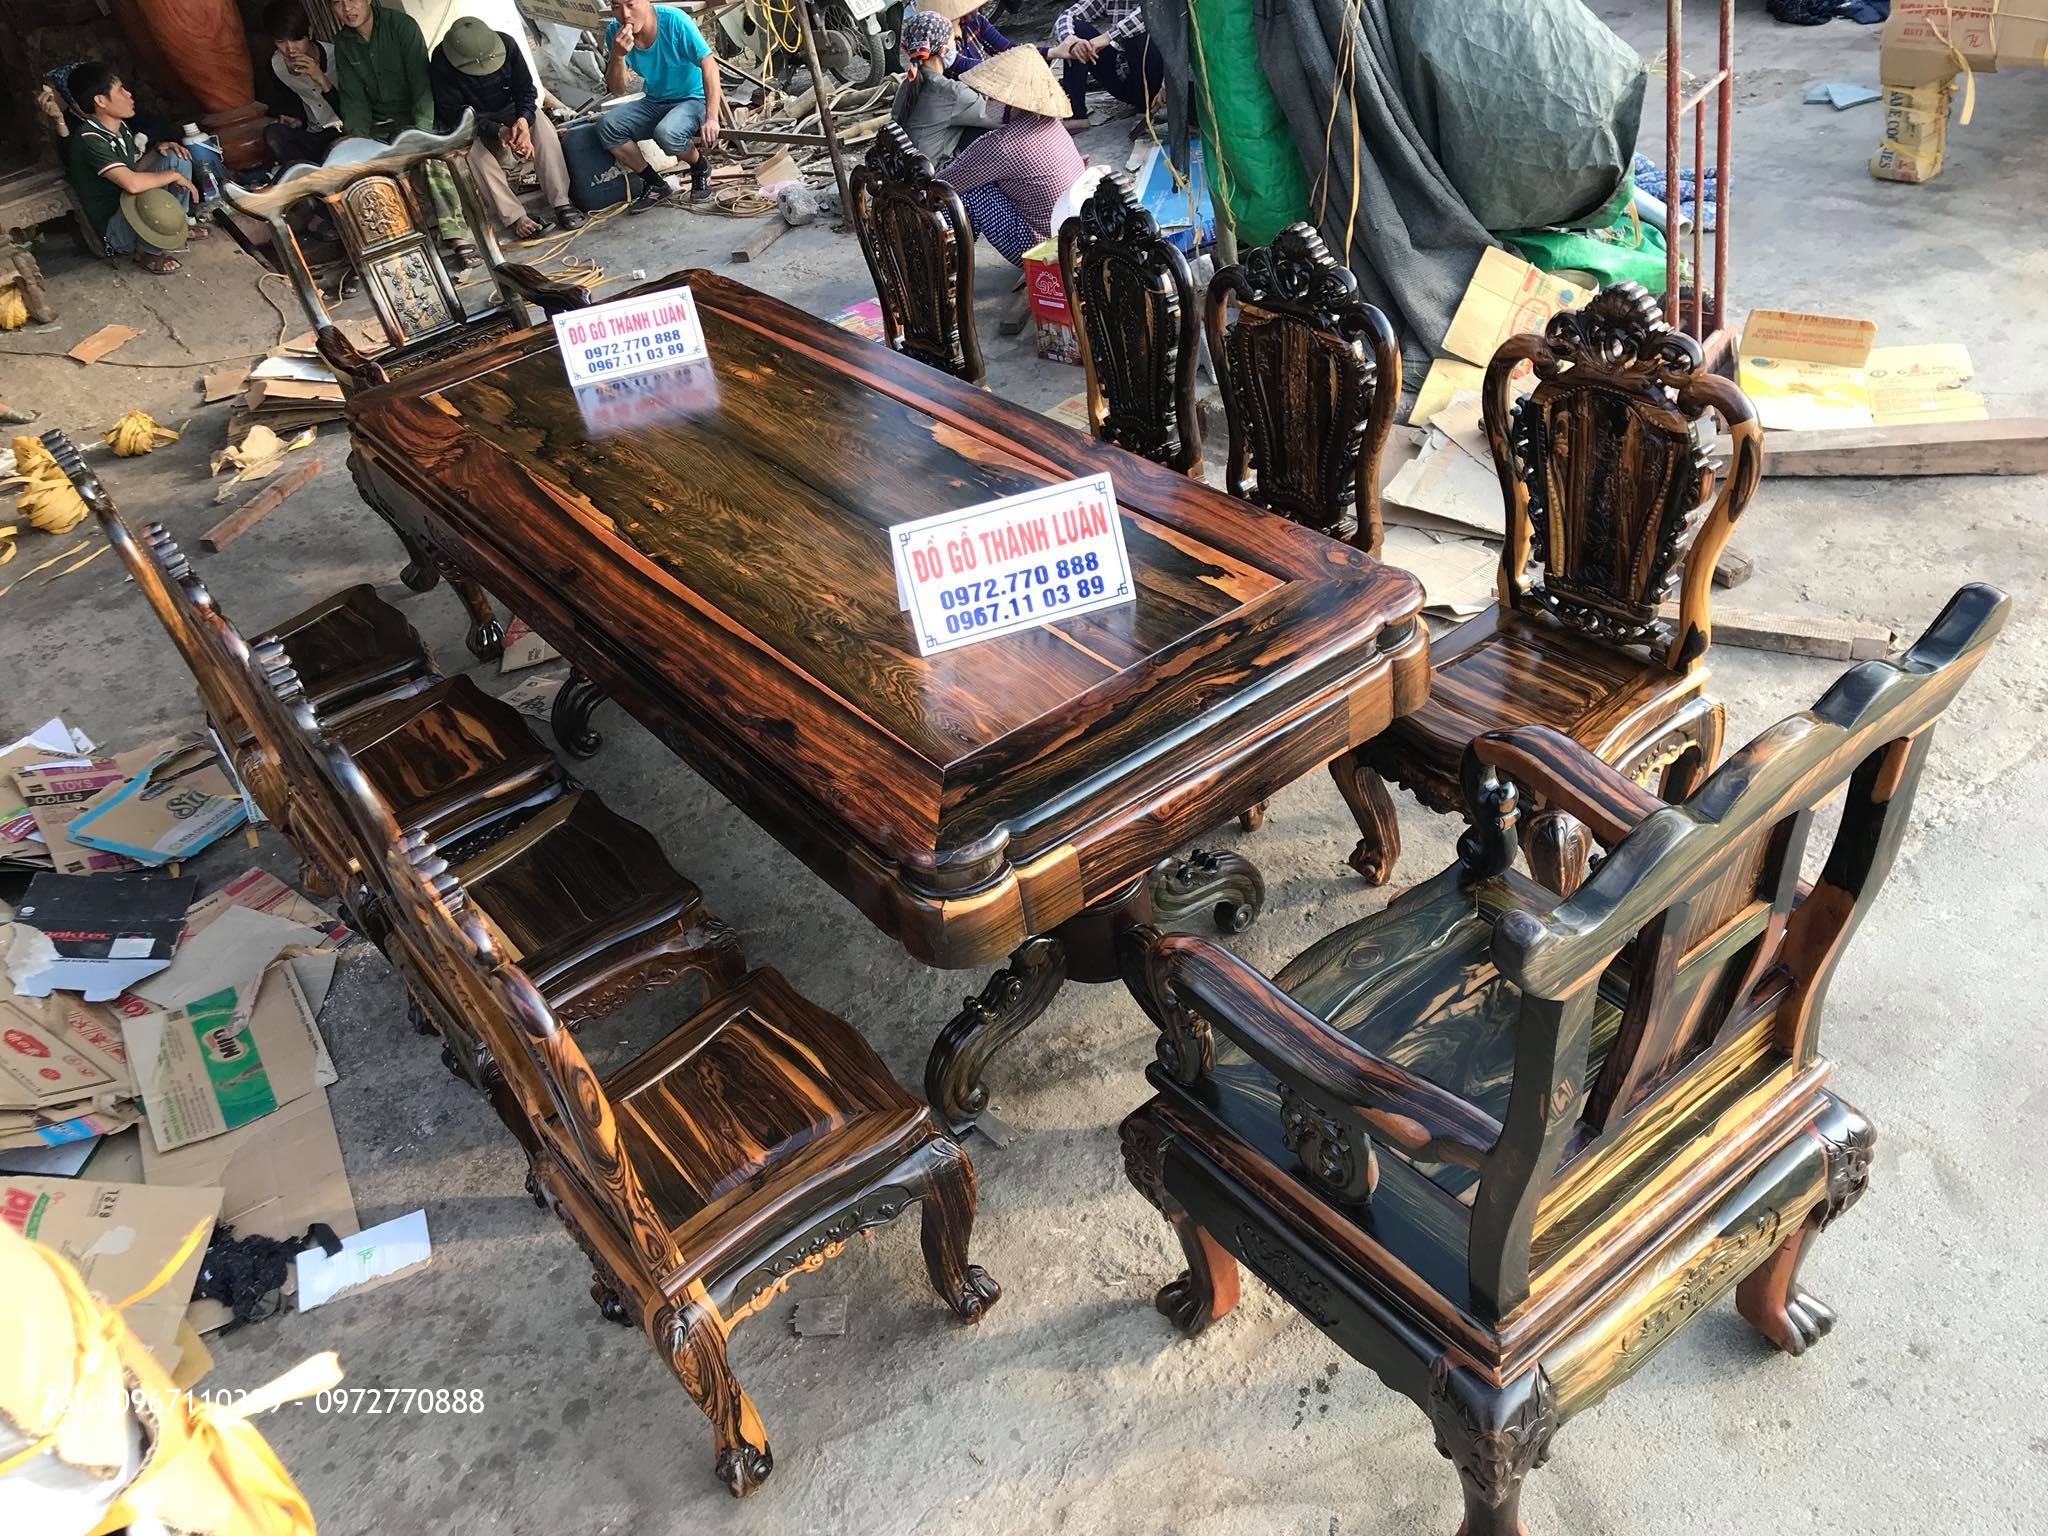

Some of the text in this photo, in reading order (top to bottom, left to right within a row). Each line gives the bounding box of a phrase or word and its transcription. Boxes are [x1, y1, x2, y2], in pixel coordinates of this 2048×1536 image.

[568, 302, 687, 346] ĐỒ GỖ THÀNH LUÂN
[585, 329, 681, 360] 0972.770 888
[588, 342, 685, 374] 0967.11 03 89
[912, 501, 1109, 583] ĐỒ GỖ THÀNH LUÂN
[940, 551, 1100, 611] 0972.770 888
[945, 575, 1105, 634] 0967.11 03 89
[35, 792, 83, 805] DOLLS
[55, 779, 95, 792] TOYS
